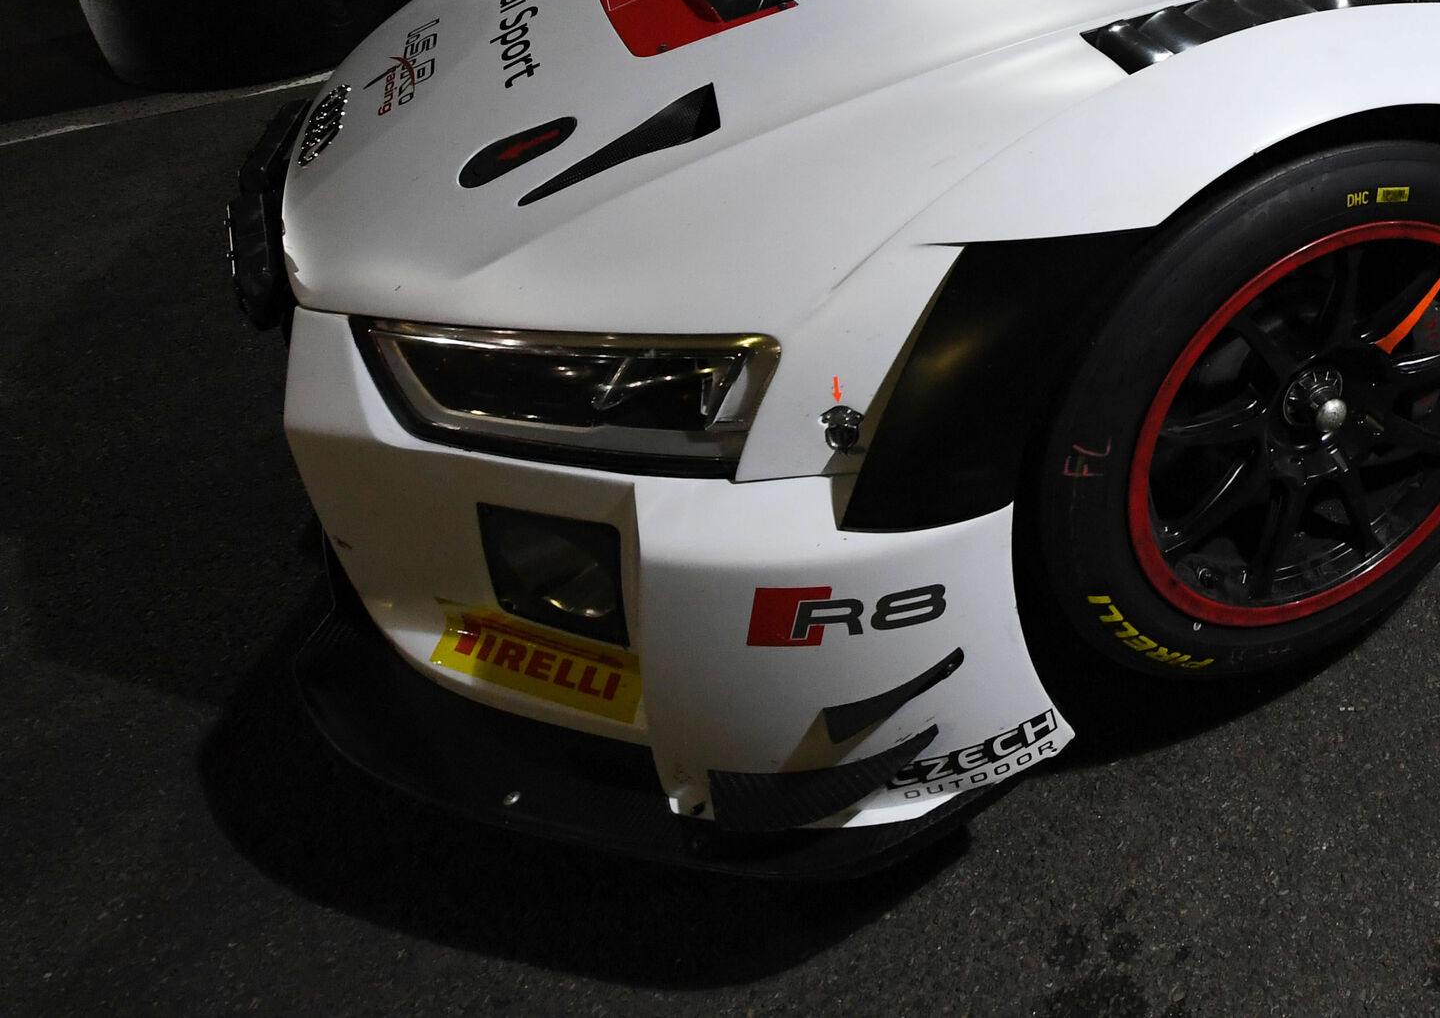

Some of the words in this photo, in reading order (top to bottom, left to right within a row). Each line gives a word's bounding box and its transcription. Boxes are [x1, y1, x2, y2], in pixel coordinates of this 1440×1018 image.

[490, 5, 541, 89] Sport
[377, 66, 397, 116] racing
[1347, 191, 1369, 208] DHC
[1063, 436, 1112, 479] FL
[792, 583, 947, 640] R8
[1087, 595, 1215, 670] PIRELLI
[454, 614, 625, 702] PIRELLI
[904, 740, 1055, 799] OUTDOOR
